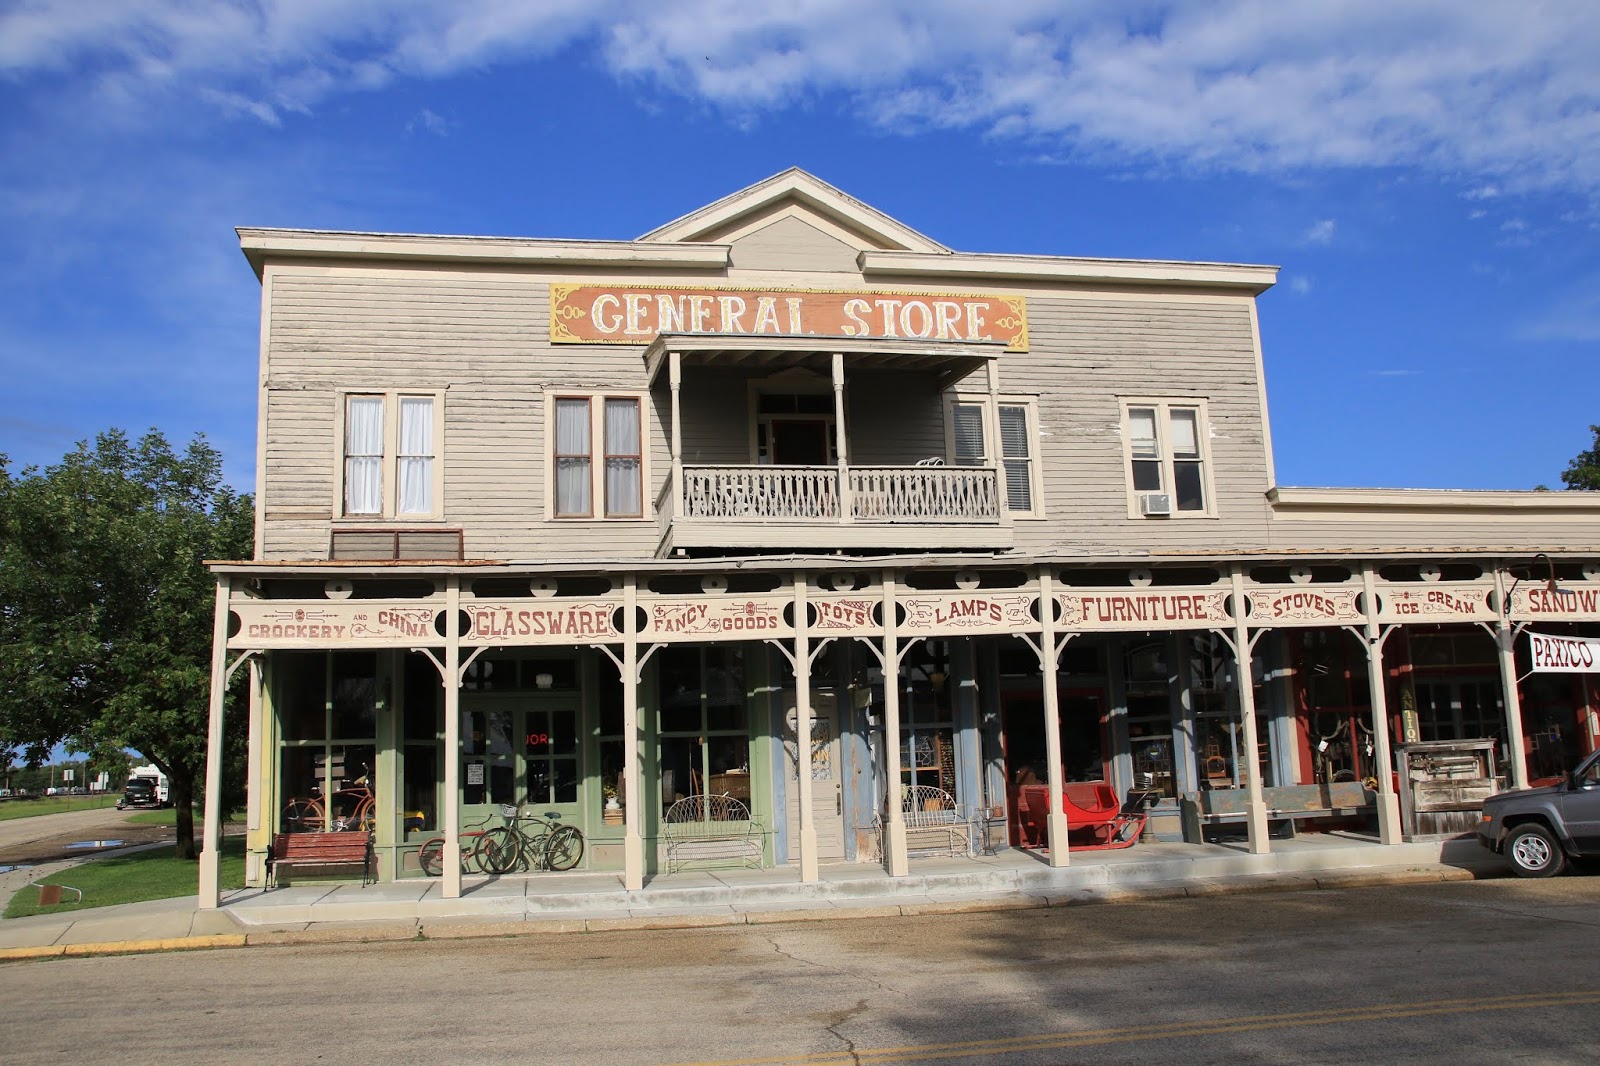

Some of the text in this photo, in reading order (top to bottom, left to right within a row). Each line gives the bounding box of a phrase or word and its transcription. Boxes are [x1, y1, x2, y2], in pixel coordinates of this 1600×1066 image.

[591, 293, 992, 341] GENERAL STORE
[935, 599, 1003, 624] LAMPS
[1080, 595, 1208, 622] FURNITURE
[1273, 594, 1336, 618] STOVES
[1395, 591, 1476, 614] ICE CREAM
[1528, 588, 1600, 612] SANDW
[249, 624, 346, 639] CROCKERY
[378, 611, 429, 637] CHINA
[475, 610, 608, 636] GLASSWARE
[654, 604, 778, 632] FANCY GOODS
[822, 602, 866, 625] TOYS
[1533, 637, 1593, 668] PAXICO
[1403, 688, 1417, 743] ANTIQ
